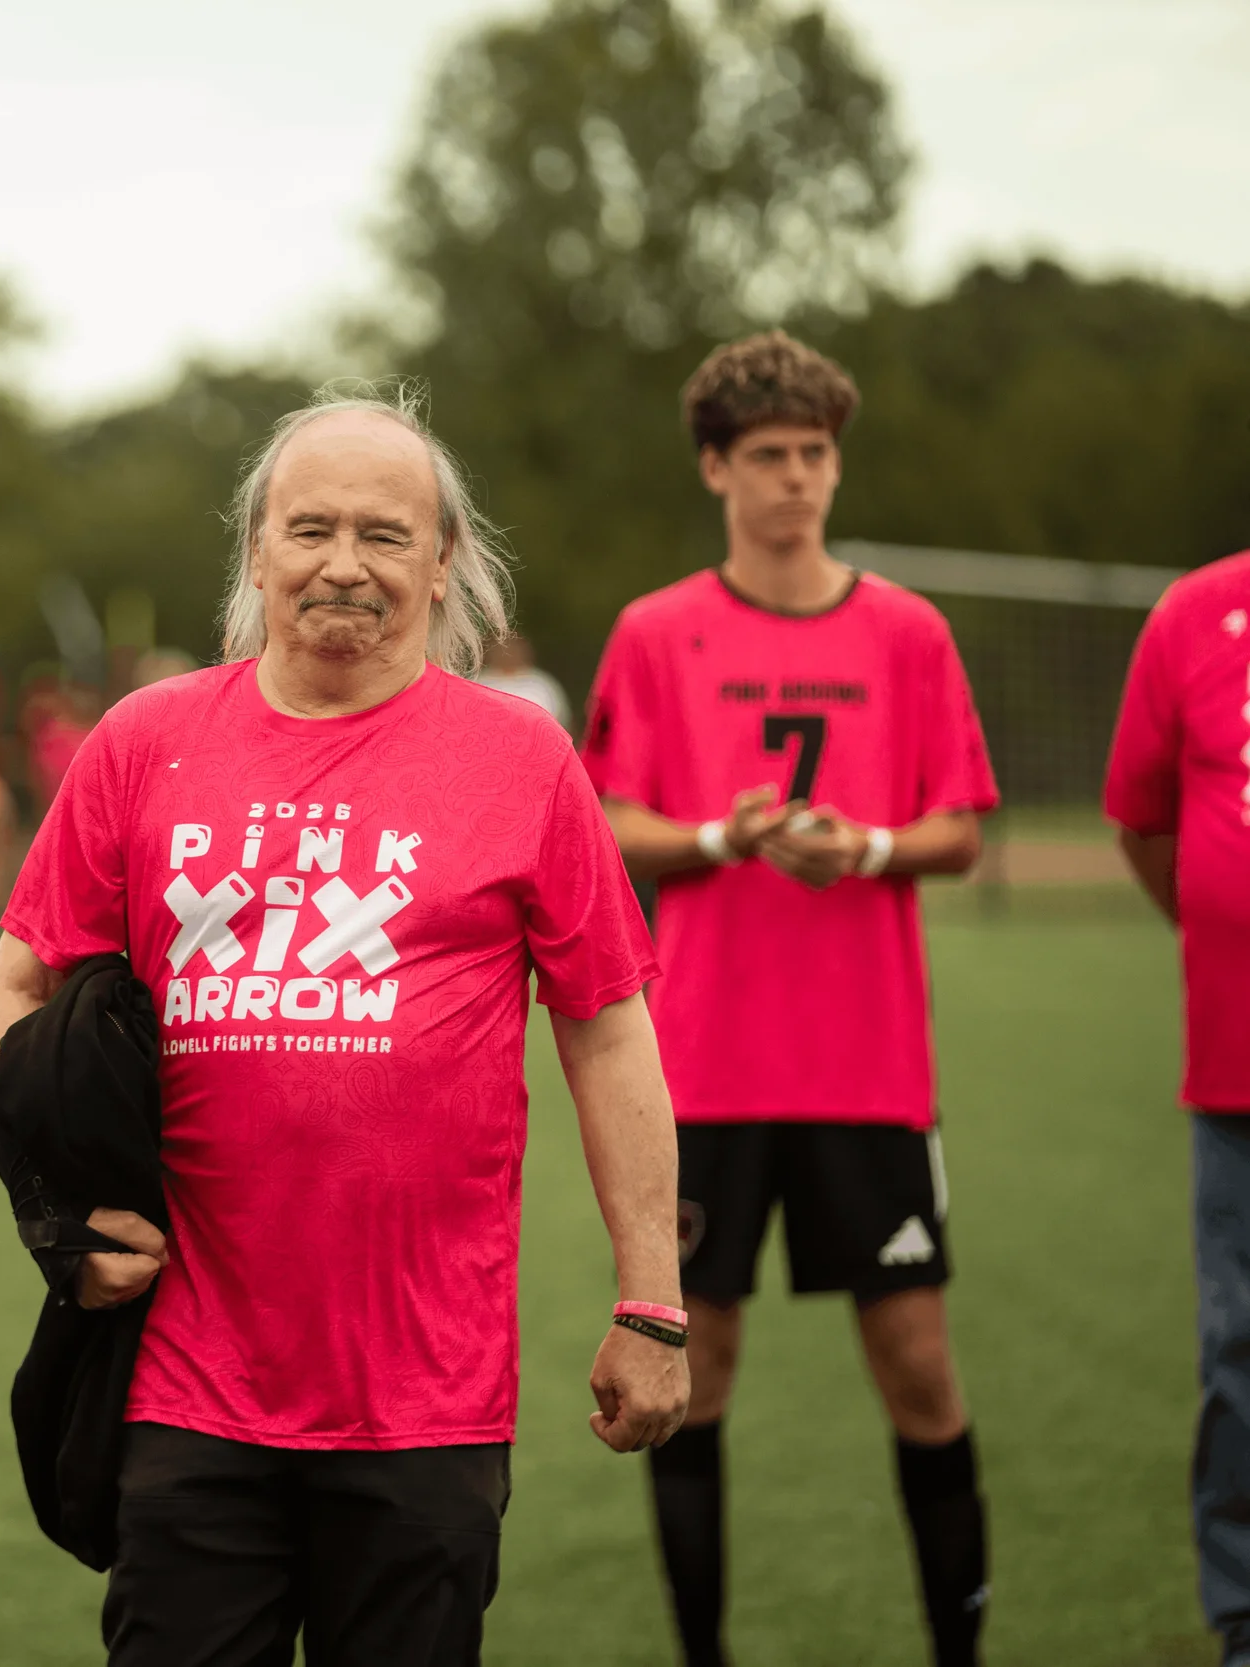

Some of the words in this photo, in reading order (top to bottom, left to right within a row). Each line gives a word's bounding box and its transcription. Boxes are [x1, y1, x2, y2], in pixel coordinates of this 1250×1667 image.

[763, 715, 826, 809] 7
[248, 802, 352, 821] 2026
[162, 975, 400, 1027] ARROW
[162, 1036, 210, 1056] LOWELL
[283, 1035, 393, 1054] TOGETHER
